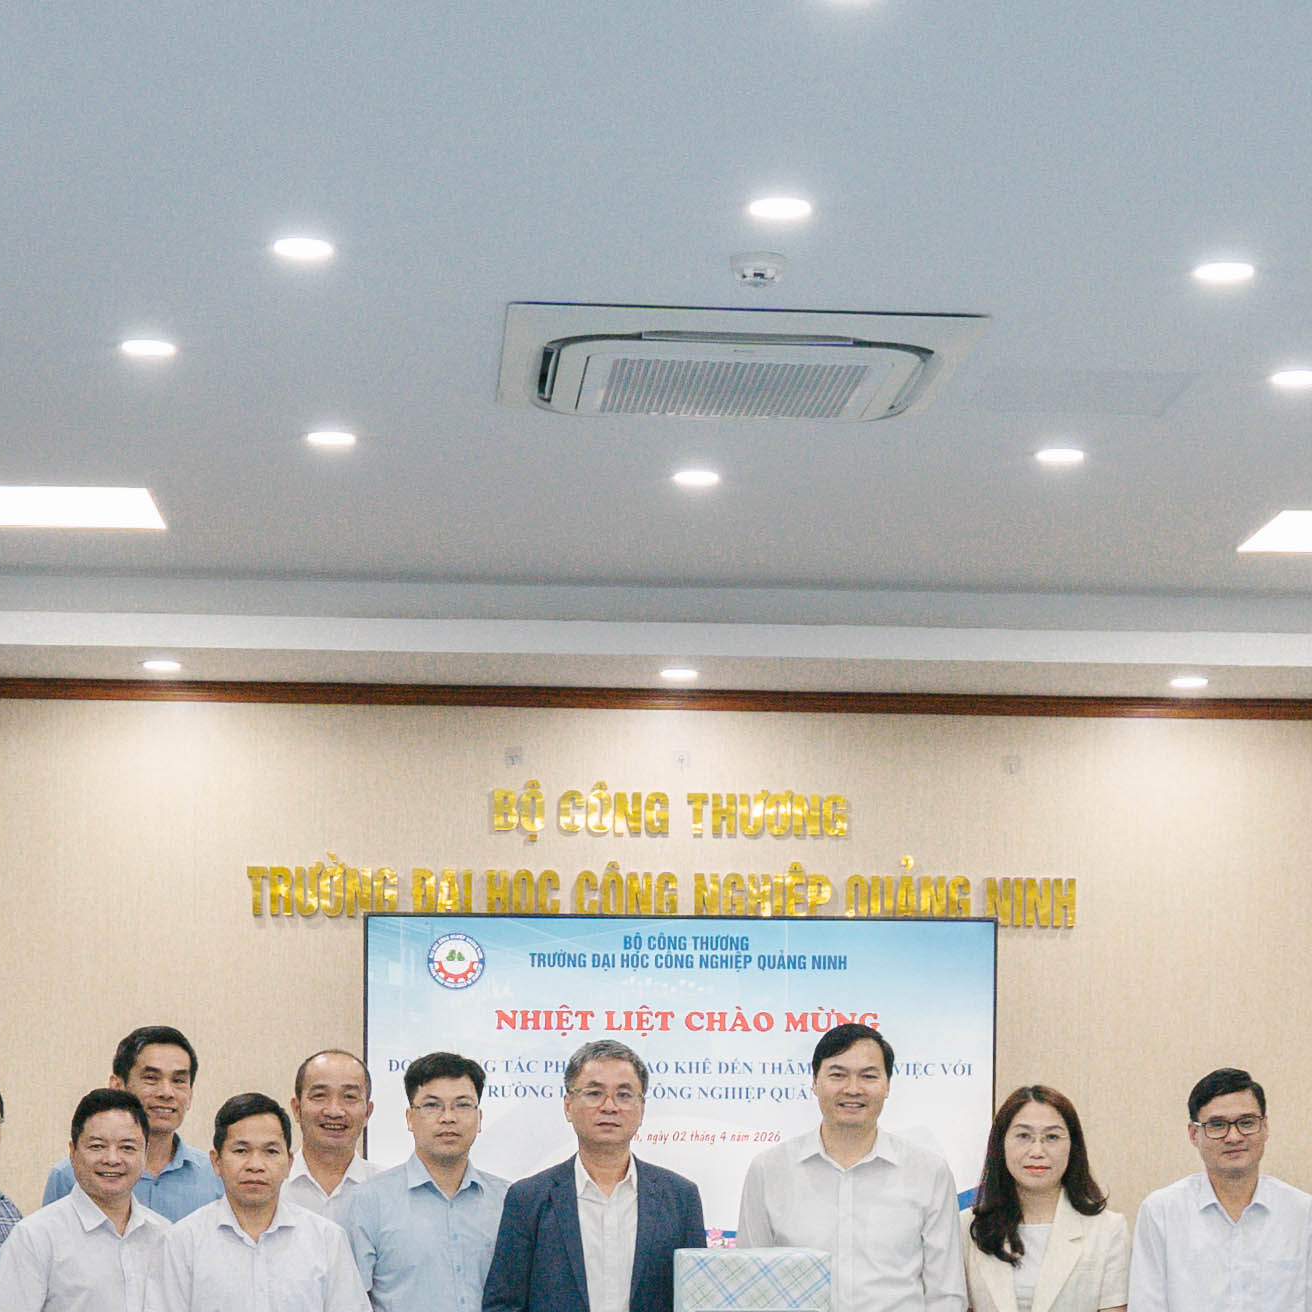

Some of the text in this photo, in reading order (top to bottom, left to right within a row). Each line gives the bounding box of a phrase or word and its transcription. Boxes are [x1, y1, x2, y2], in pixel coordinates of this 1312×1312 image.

[492, 779, 848, 842] BỘ CÔNG THƯƠNG
[246, 851, 398, 917] TRƯỜNG
[575, 861, 678, 914] CÔNG
[845, 854, 972, 917] QUẢNG
[985, 877, 1076, 928] NINH
[623, 932, 750, 952] BỘ CÔNG THƯƠNG
[529, 949, 848, 973] TRƯỜNG ĐẠI HỌC CÔNG NGHIỆP QUẢNG NINH
[495, 1004, 595, 1037] NHIỆT
[604, 1004, 675, 1037] LIỆT
[684, 1006, 775, 1033] CHÀO
[503, 1056, 539, 1073] TÁC
[674, 1058, 713, 1075] KHÊ
[718, 1057, 755, 1075] ĐẾN
[940, 1060, 973, 1077] VỚI
[486, 1083, 553, 1098] RƯỜNG
[698, 1085, 765, 1103] NGHIỆP
[646, 1131, 669, 1145] ngày
[672, 1131, 686, 1142] 02
[690, 1131, 716, 1144] tháng
[719, 1132, 727, 1143] 4
[730, 1132, 750, 1143] năm
[753, 1131, 781, 1143] 2026
